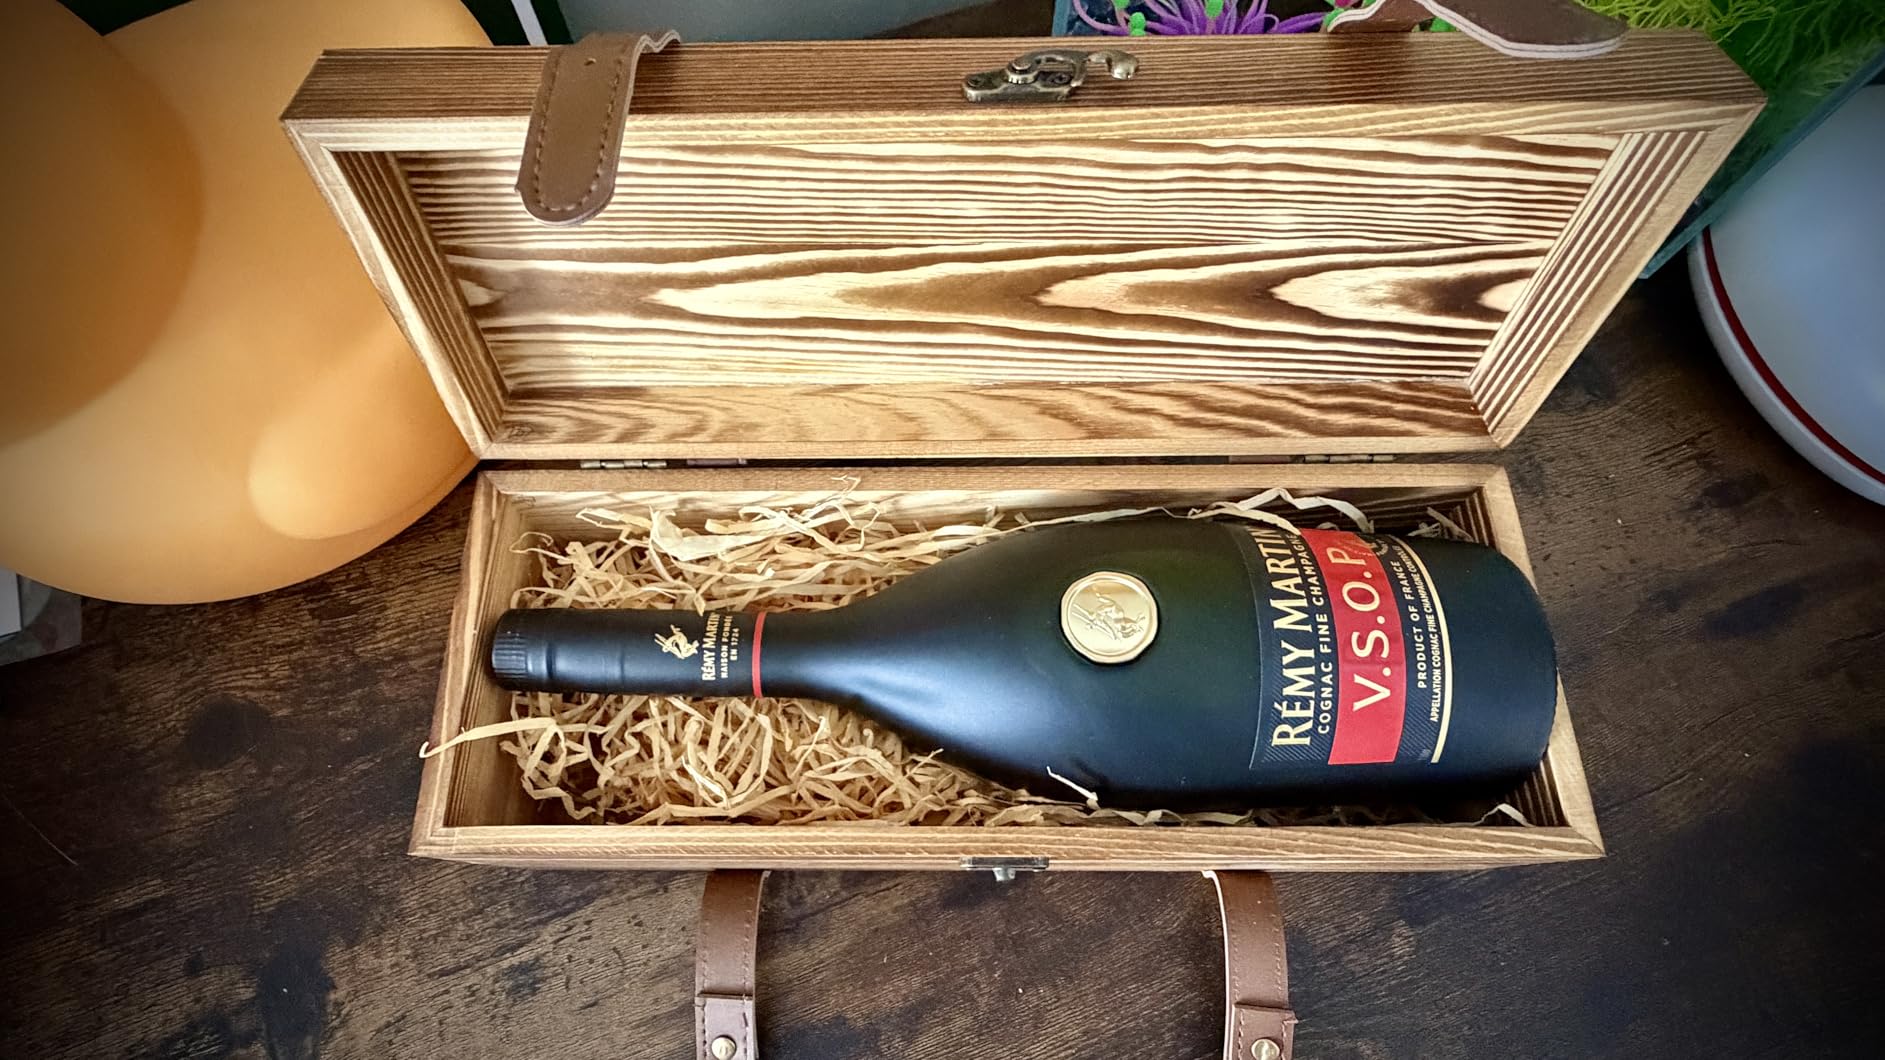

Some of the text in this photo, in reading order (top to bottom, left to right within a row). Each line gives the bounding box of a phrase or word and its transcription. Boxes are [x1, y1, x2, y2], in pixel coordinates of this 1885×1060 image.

[1412, 573, 1433, 613] CHAMPAGNE
[700, 612, 720, 680] RÉMY MARTIN
[730, 628, 740, 660] EN 1724
[1245, 526, 1316, 746] RÉMY MARTIN
[1286, 533, 1333, 734] COGNAC FINE CHAMPAGNE
[1391, 560, 1427, 688] PRODUCT OF FRANCE
[1426, 614, 1438, 632] FINE
[720, 645, 728, 678] MAISON
[1429, 633, 1441, 668] COGNAC
[1429, 668, 1441, 722] APPELLATION
